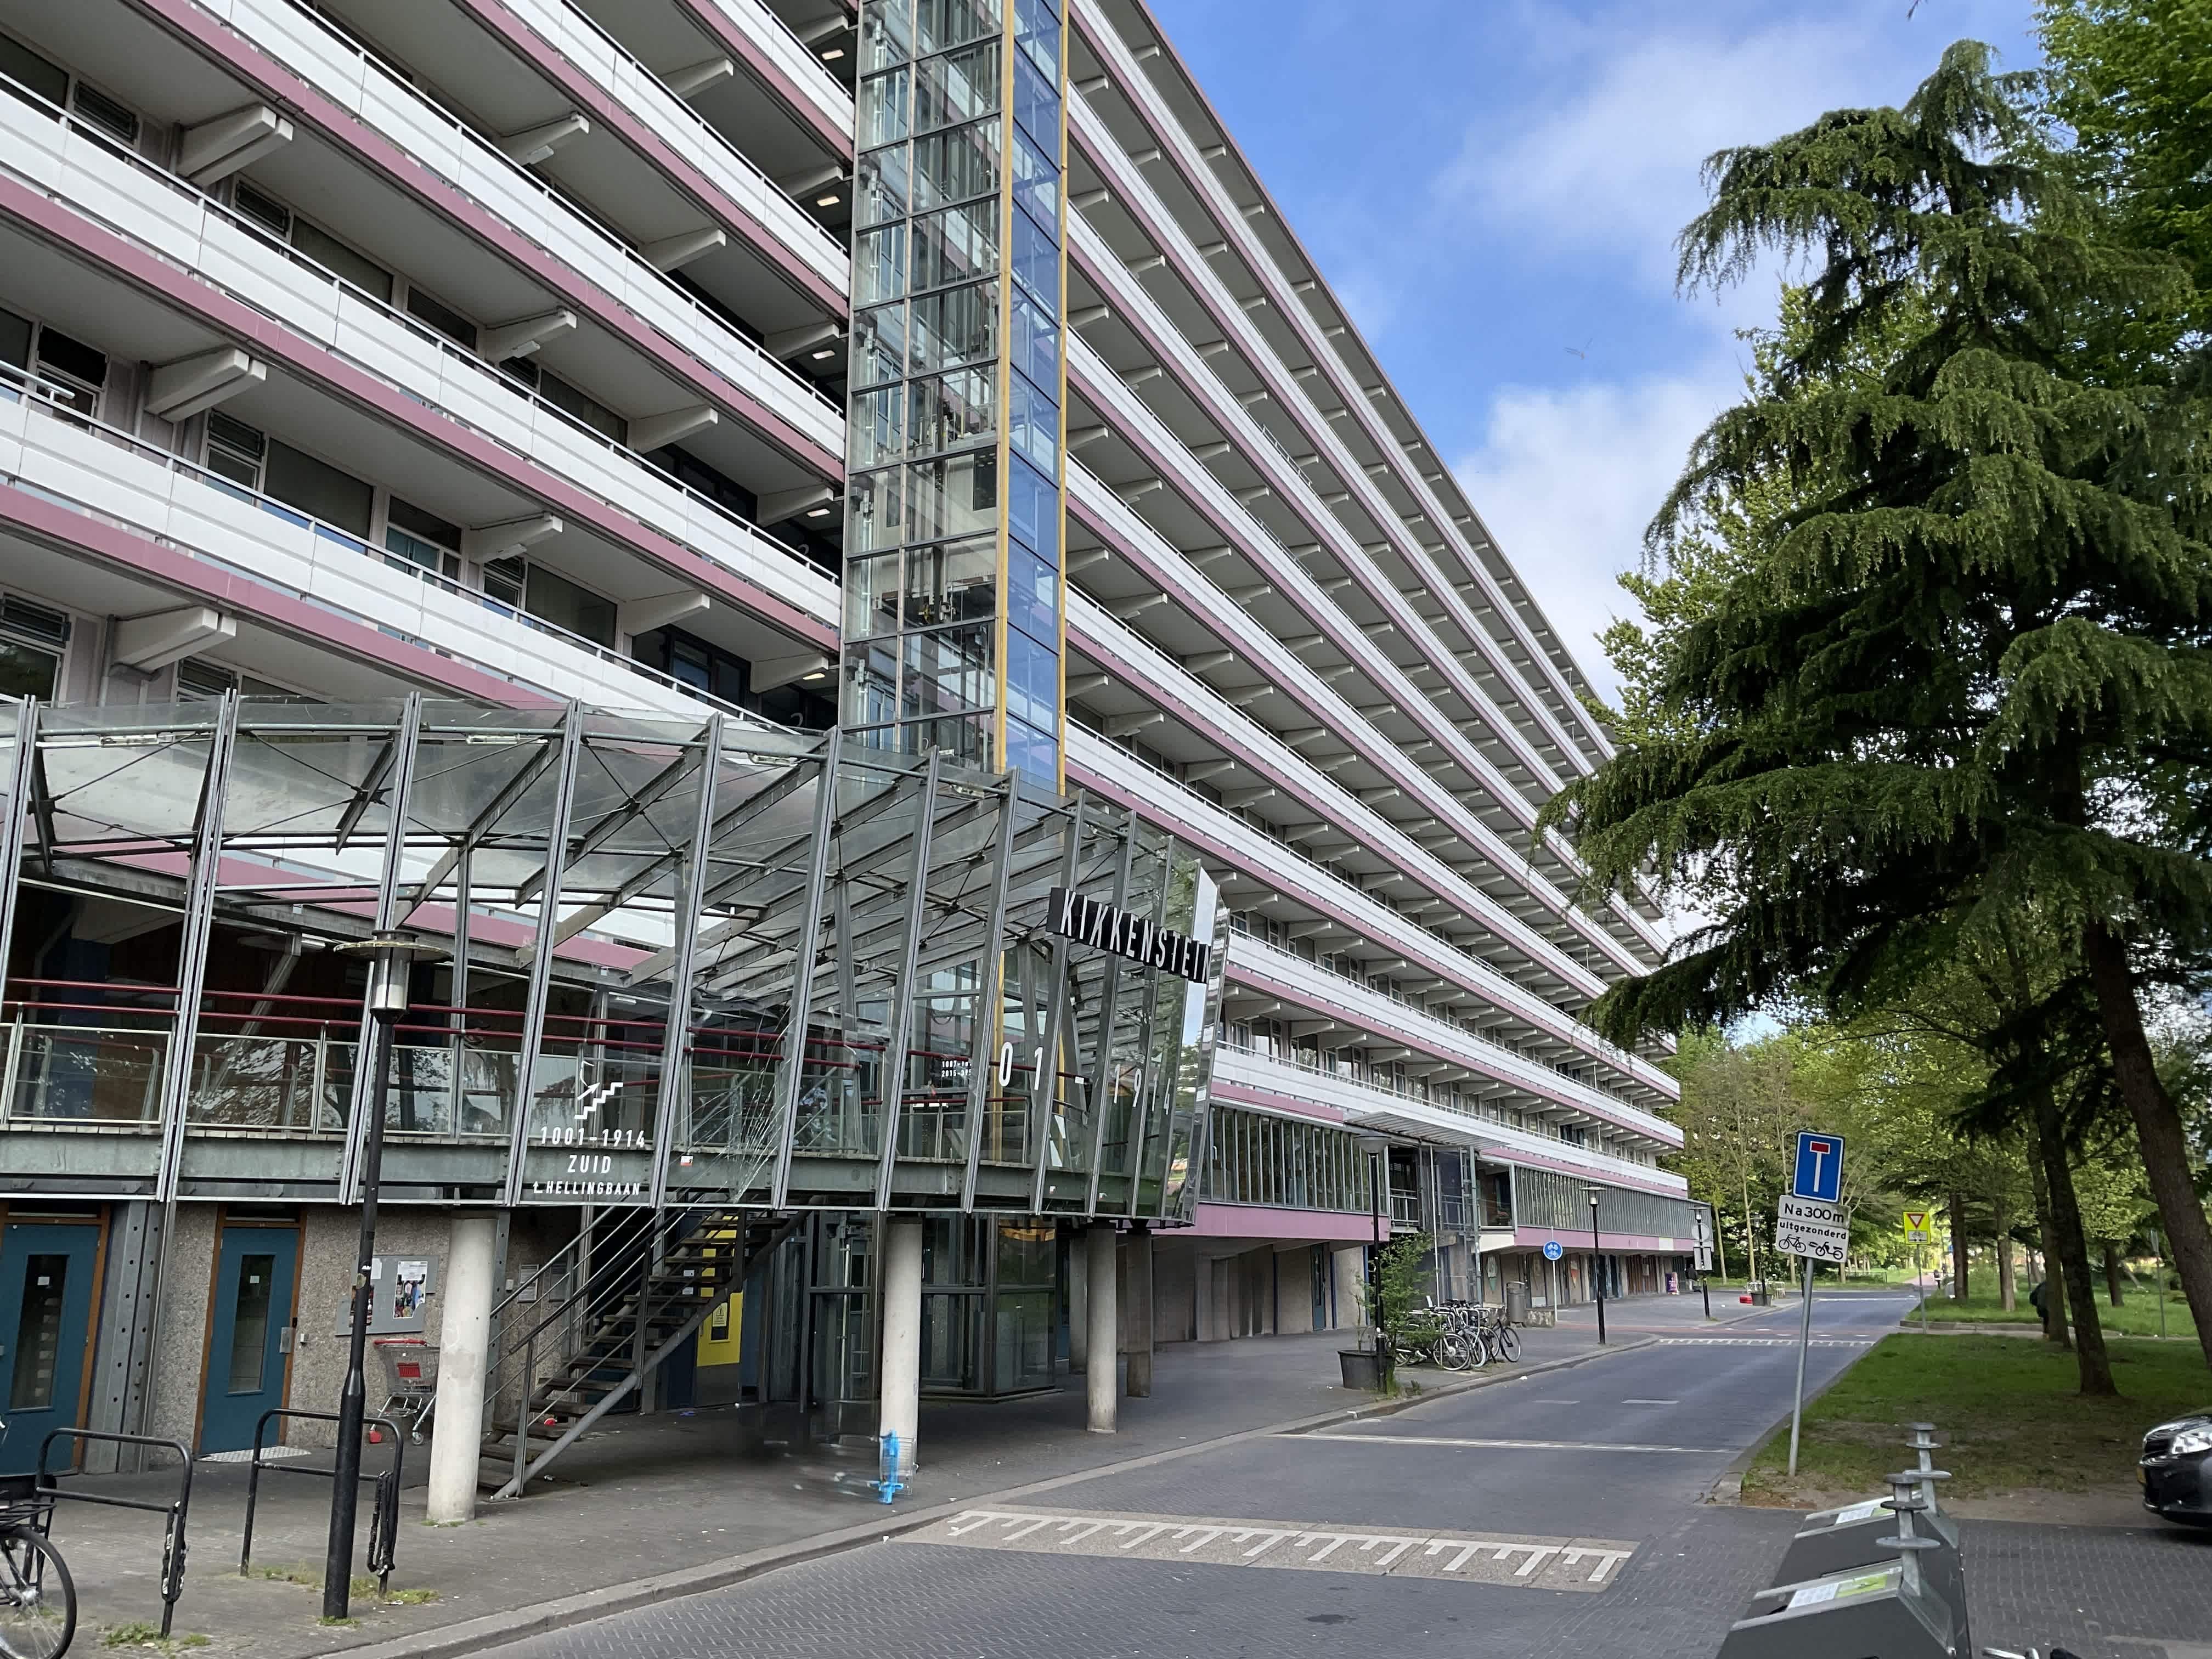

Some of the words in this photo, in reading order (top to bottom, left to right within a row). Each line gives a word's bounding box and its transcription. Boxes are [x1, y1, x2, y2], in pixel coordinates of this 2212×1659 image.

[1060, 888, 1212, 983] KIKKENSTEIN
[540, 1126, 645, 1147] 1001-1914
[567, 1154, 611, 1173] ZUID
[545, 1180, 640, 1195] HELLINGBAAN
[1780, 1221, 1847, 1240] uitgezonderd
